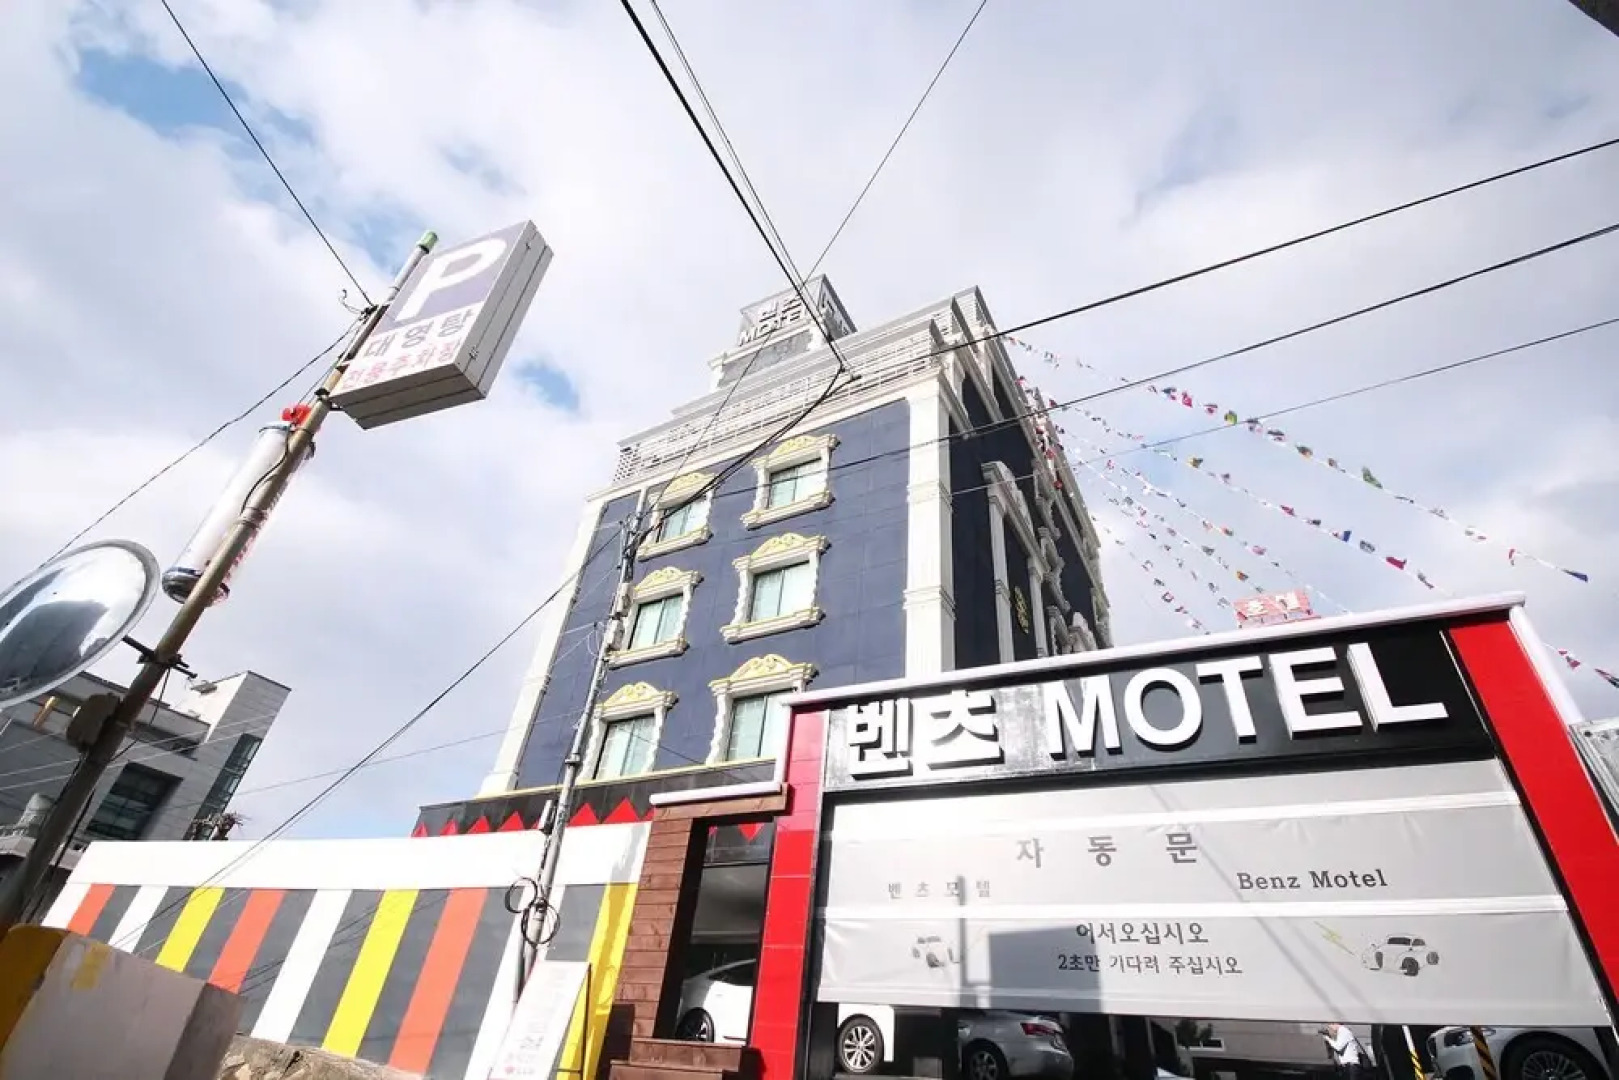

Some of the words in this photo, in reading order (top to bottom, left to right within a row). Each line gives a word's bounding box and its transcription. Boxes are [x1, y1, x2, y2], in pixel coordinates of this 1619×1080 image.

[394, 238, 507, 322] P
[364, 309, 475, 357] 대영탕
[847, 689, 1004, 780] 벤츠
[1043, 643, 1449, 761] MOTEL
[1237, 872, 1300, 890] Benz
[1309, 869, 1388, 889] Motel
[1076, 922, 1208, 945] 어서오십시오
[1058, 954, 1101, 973] 2초만
[1168, 955, 1243, 975] 주십시오
